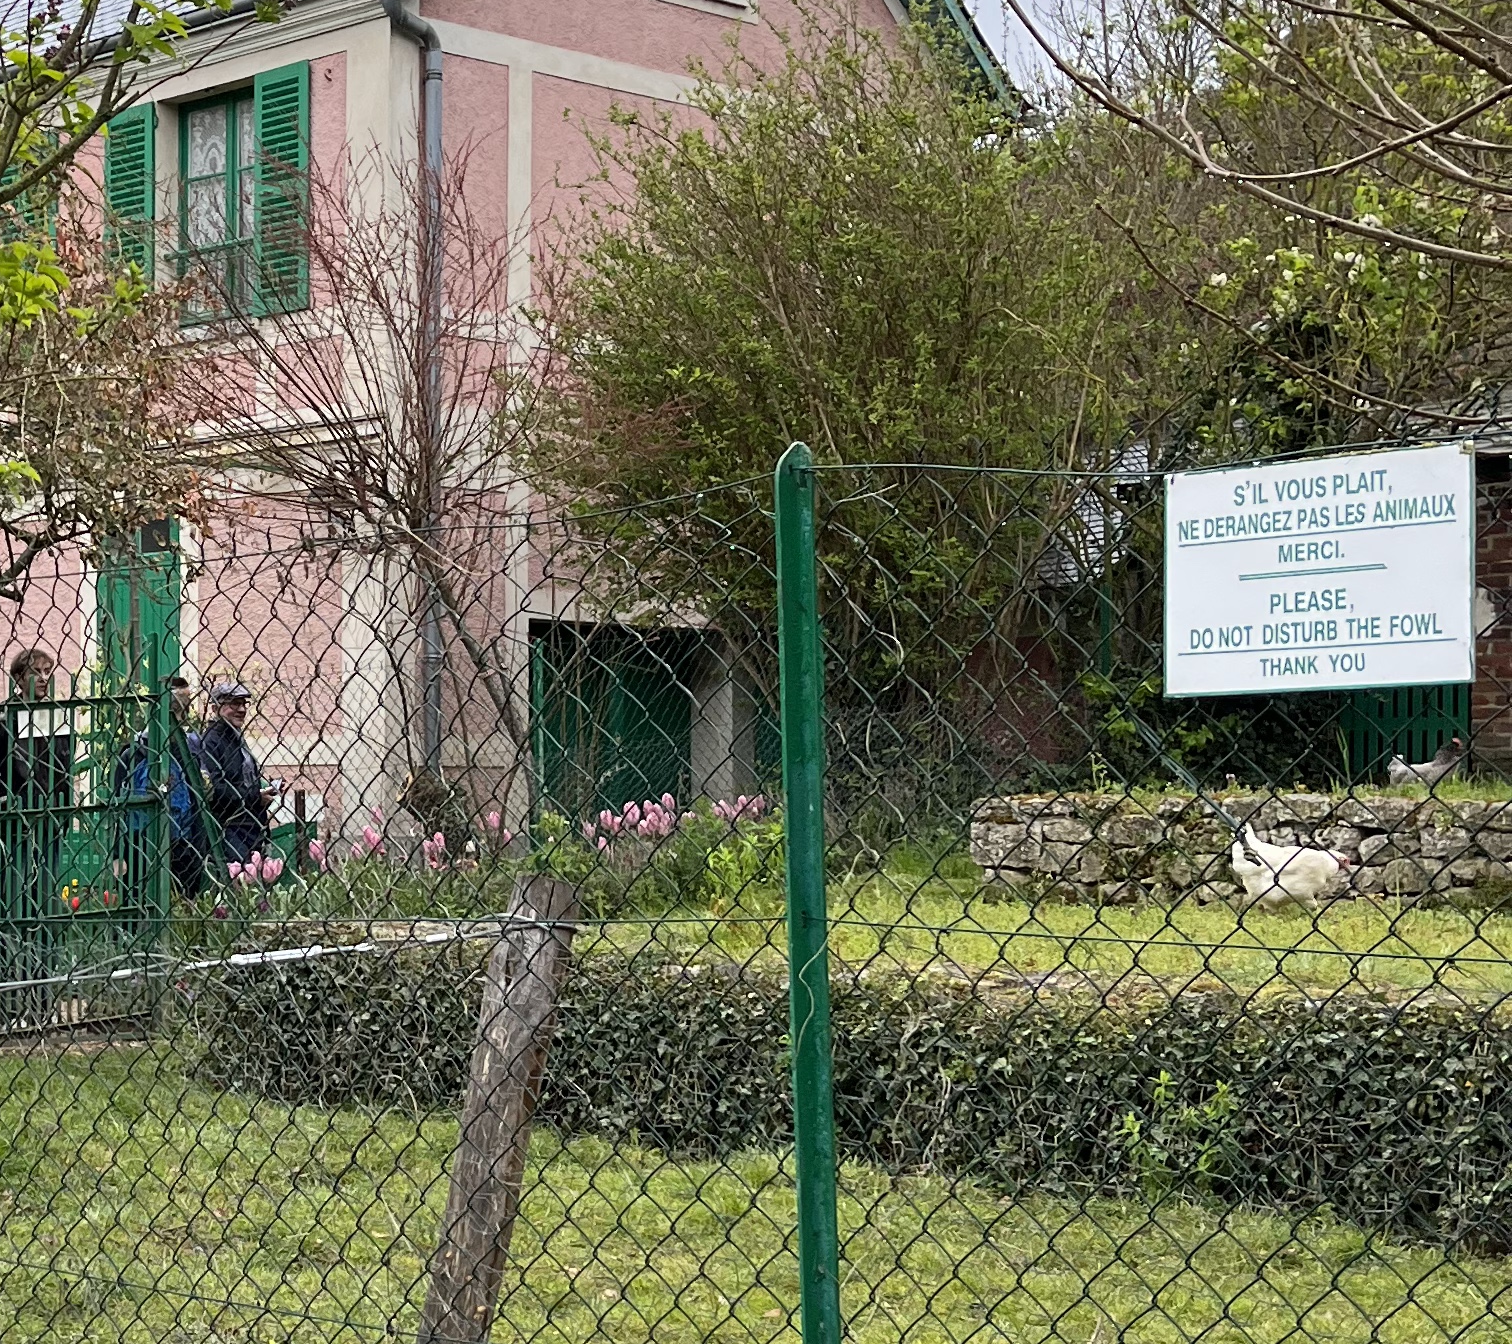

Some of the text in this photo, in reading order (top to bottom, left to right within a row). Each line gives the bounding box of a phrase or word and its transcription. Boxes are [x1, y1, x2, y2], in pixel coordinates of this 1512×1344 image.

[1234, 469, 1393, 506] S'IL VOUS PLAIT,
[1178, 493, 1456, 542] NE DERANGEZ PAS LES ANIMAUX
[1278, 540, 1345, 563] MERCI.
[1270, 588, 1355, 614] PLEASE,
[1190, 612, 1443, 650] DO NOT DISTURB THE FOWL
[1260, 652, 1366, 677] THANK YOU
